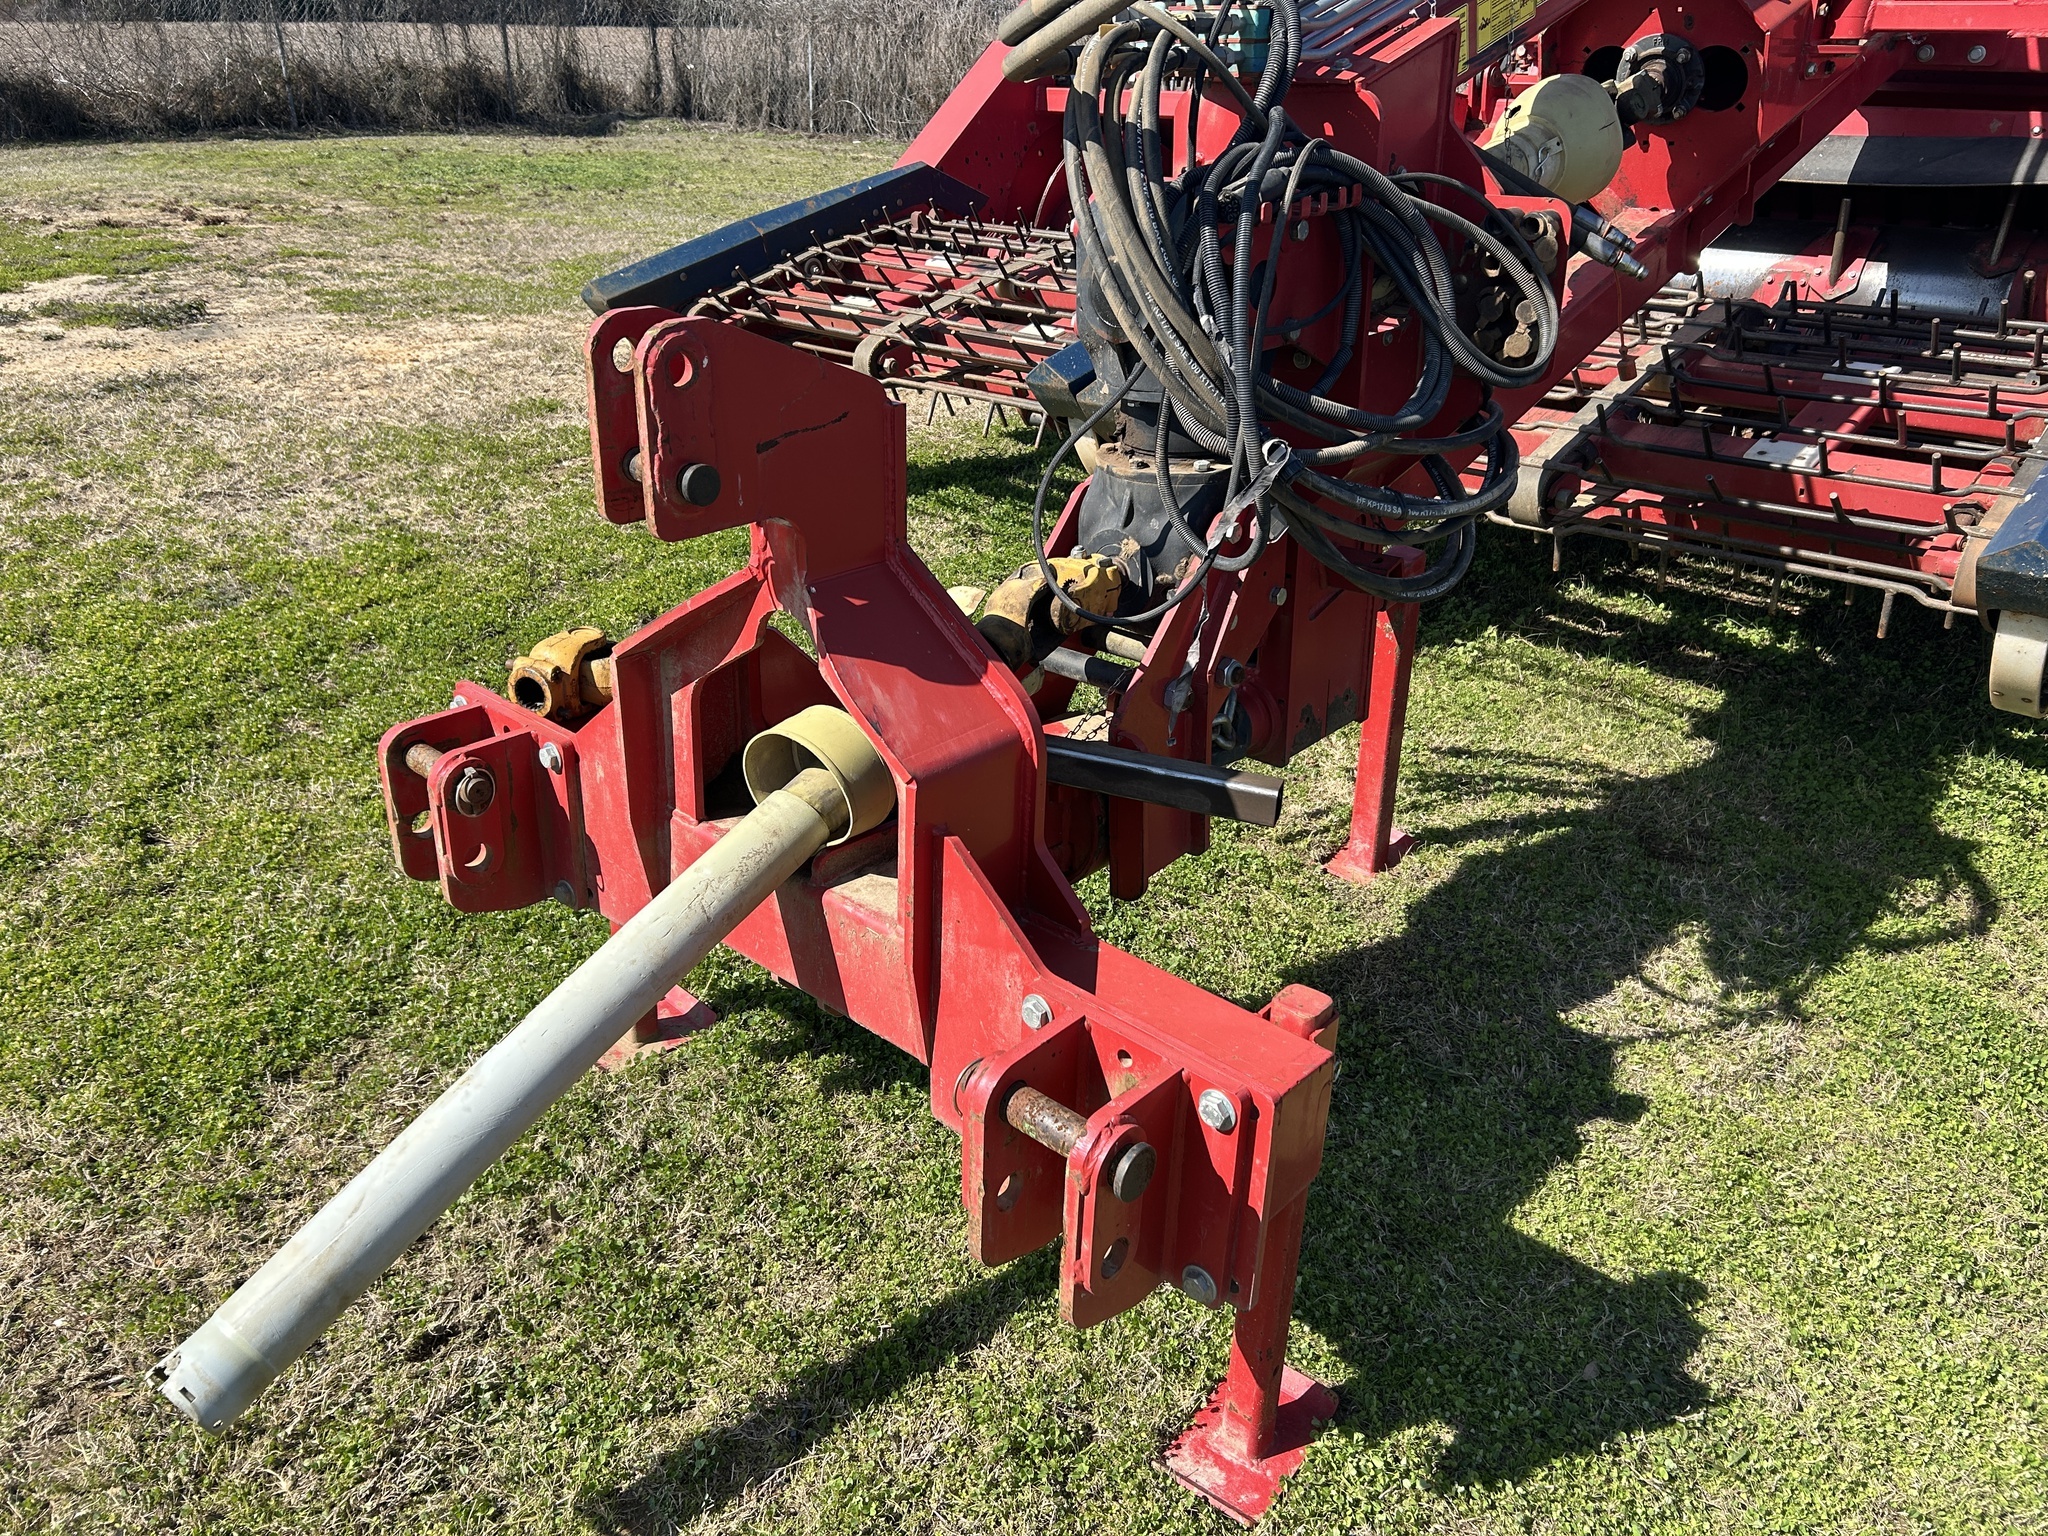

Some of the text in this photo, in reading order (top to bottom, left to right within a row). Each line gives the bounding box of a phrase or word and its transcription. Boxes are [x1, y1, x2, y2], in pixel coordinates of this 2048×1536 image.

[1151, 222, 1163, 245] BAR
[1174, 338, 1190, 360] SAE
[1187, 359, 1201, 374] 100
[1199, 374, 1219, 397] R17-1
[1356, 496, 1367, 504] HF
[1367, 500, 1392, 513] KP1713
[1392, 506, 1402, 515] SA
[1426, 588, 1438, 597] BAR
[1437, 582, 1450, 593] 2020
